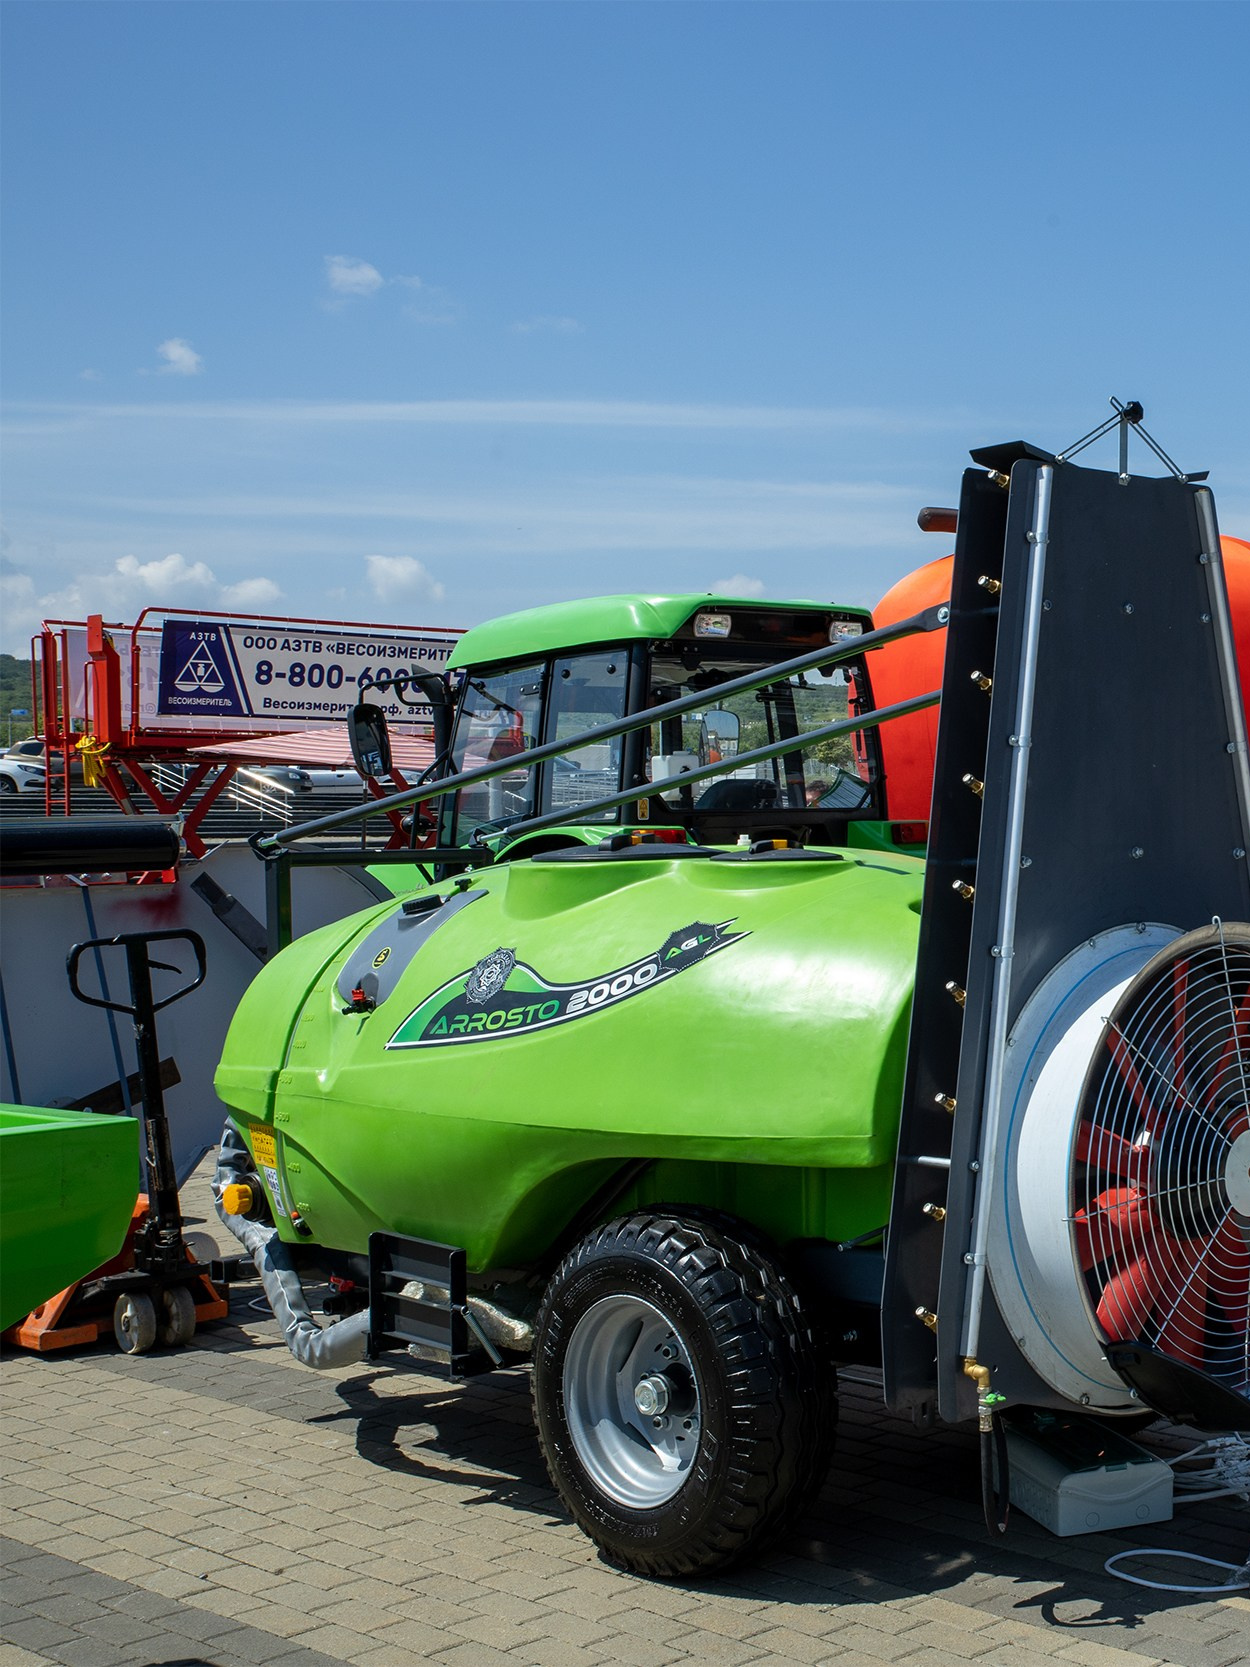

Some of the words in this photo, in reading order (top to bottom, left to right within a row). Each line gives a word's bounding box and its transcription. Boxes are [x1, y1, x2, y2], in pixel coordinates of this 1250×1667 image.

[189, 631, 217, 642] АЗТВ
[243, 635, 277, 650] ООО
[280, 638, 322, 653] АЗТВ
[168, 696, 232, 707] ВЕСОИЗМЕРИТЕЛЬ
[664, 933, 713, 961] AGL
[429, 1000, 560, 1035] ARROSTO
[565, 964, 658, 1014] 2000
